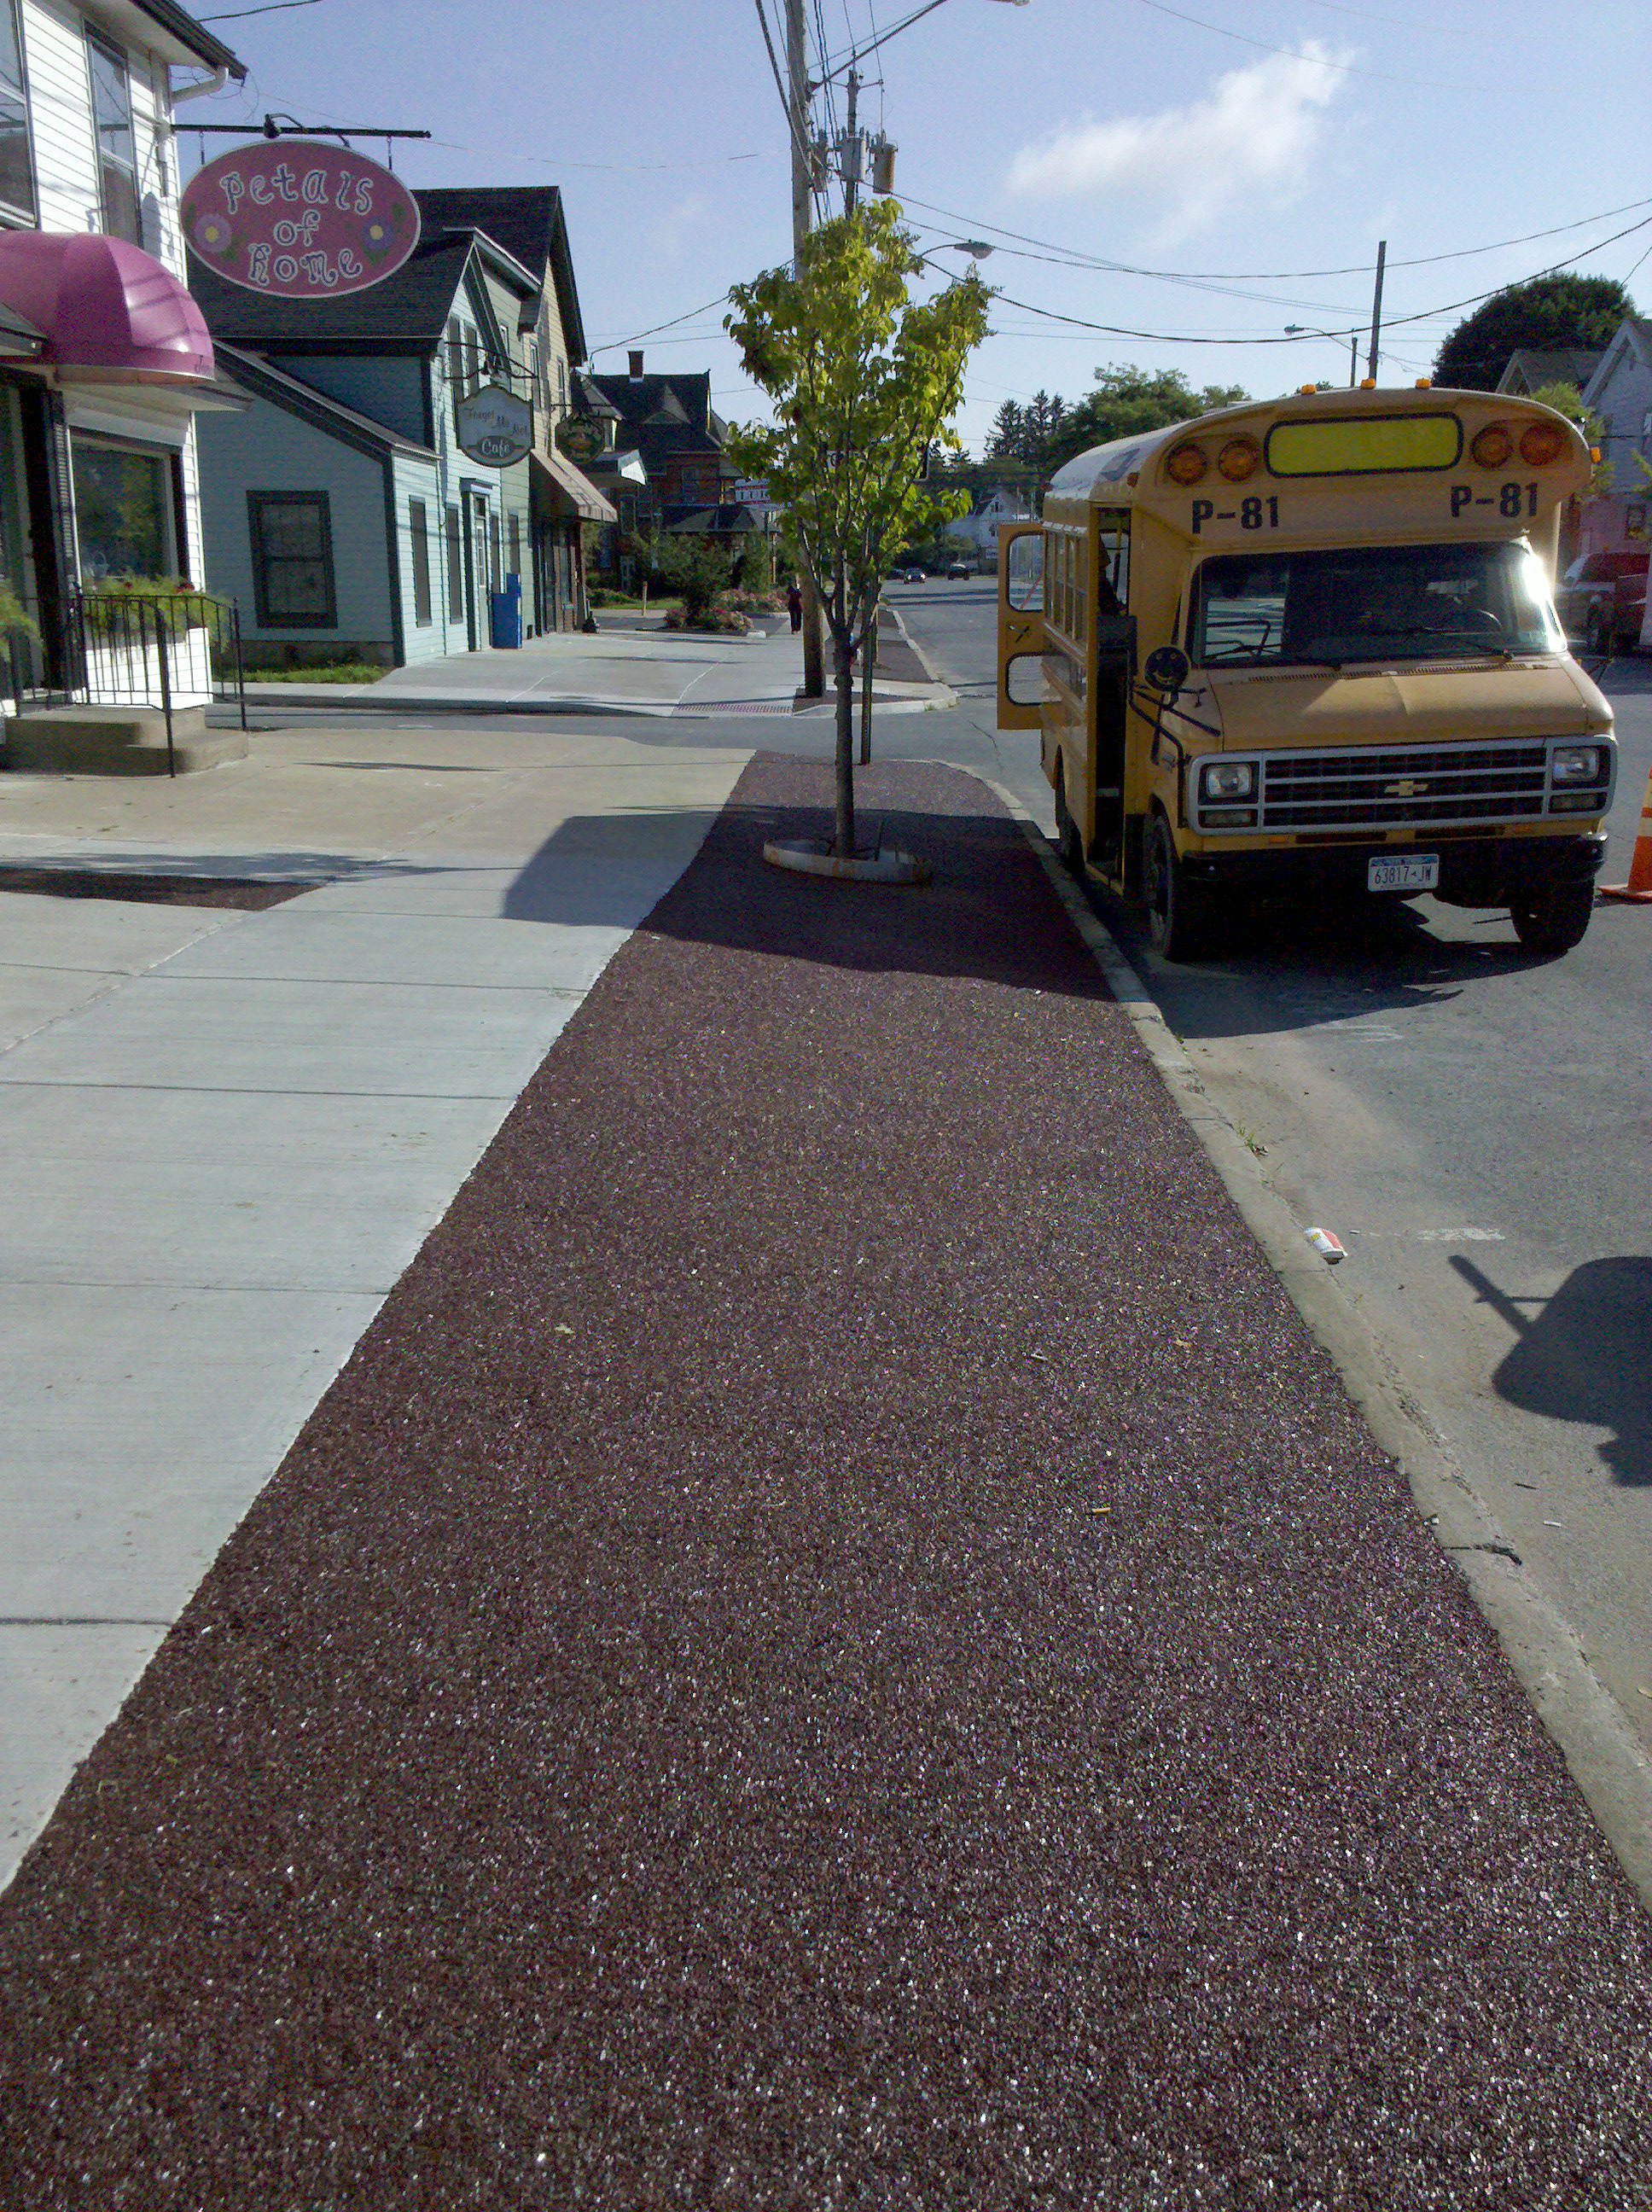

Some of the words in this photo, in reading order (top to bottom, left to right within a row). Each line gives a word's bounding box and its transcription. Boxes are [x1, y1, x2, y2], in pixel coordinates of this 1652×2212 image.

[273, 209, 321, 247] of
[247, 242, 363, 288] Rome
[1191, 495, 1280, 534] P-81
[1451, 482, 1538, 518] P-81
